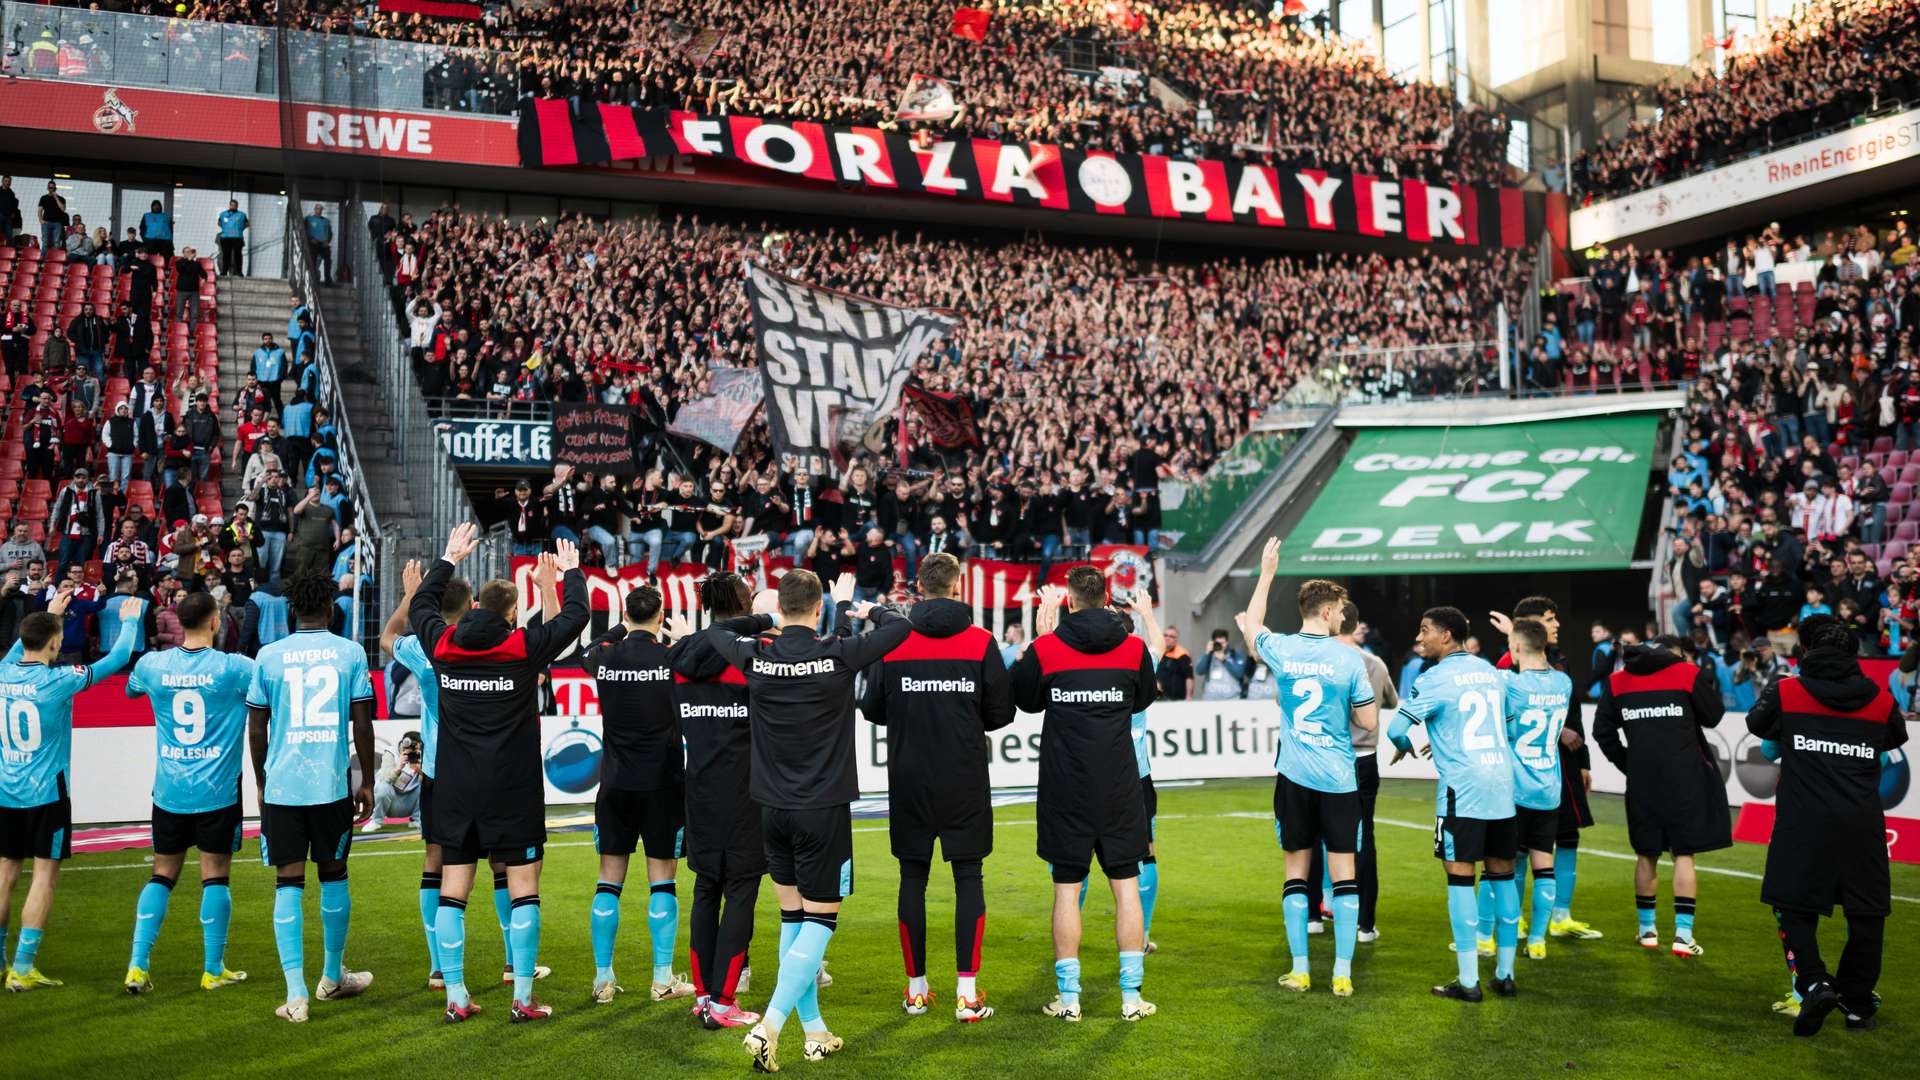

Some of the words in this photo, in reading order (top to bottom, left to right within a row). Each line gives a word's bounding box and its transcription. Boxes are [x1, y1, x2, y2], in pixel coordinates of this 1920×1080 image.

[306, 110, 433, 154] REWE
[682, 119, 1048, 200] FORZA
[1166, 160, 1466, 240] BAYER
[1353, 450, 1529, 472] Come
[1538, 446, 1638, 464] on,
[1378, 467, 1591, 508] FC!
[1311, 519, 1596, 549] DEVK
[597, 665, 671, 682] Barmenia
[751, 656, 836, 677] Barmenia
[440, 673, 515, 691] Barmenia
[901, 676, 976, 693] Barmenia
[1050, 687, 1124, 703] Barmenia
[283, 664, 340, 729] 12
[1291, 678, 1324, 734] 2
[171, 689, 206, 746] 9
[680, 702, 749, 718] Barmenia
[1458, 688, 1506, 751] 21
[1621, 703, 1683, 721] Barmenia
[0, 698, 42, 753] 10
[286, 730, 338, 745] TAPSOBA
[1514, 708, 1568, 758] 20
[160, 745, 222, 760] B.IGLESIAS
[1793, 734, 1875, 760] Barmenia
